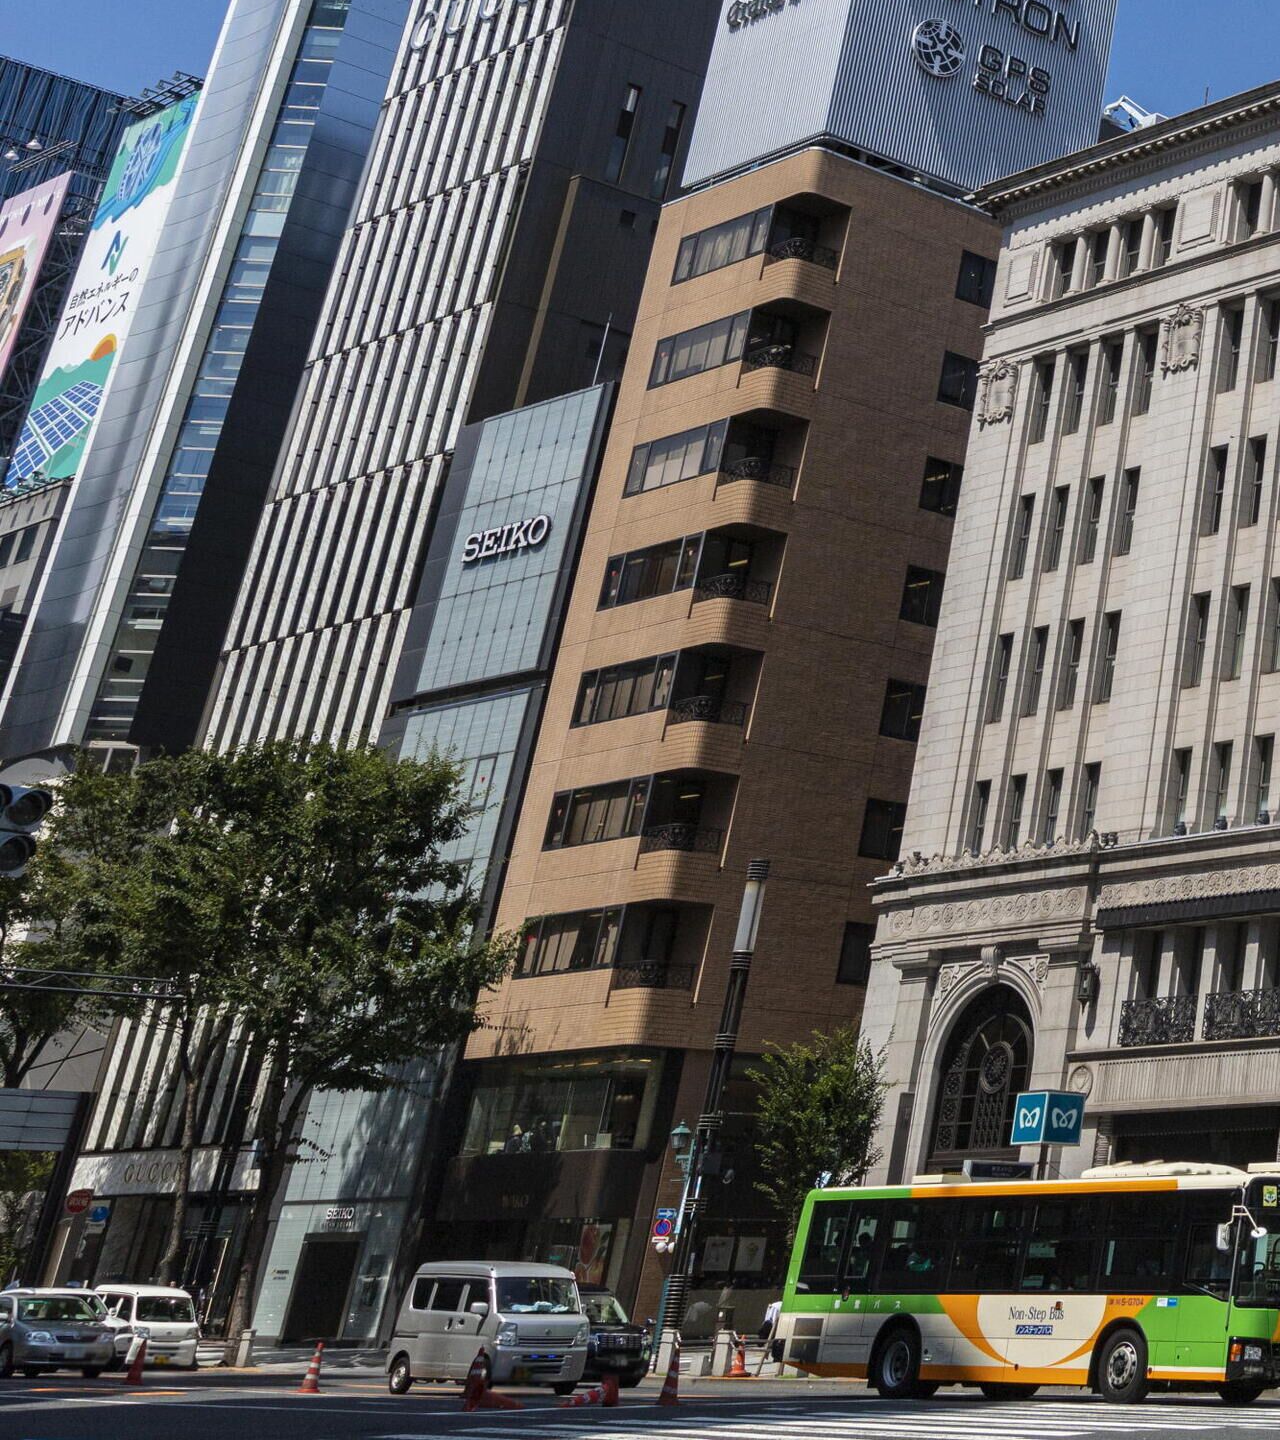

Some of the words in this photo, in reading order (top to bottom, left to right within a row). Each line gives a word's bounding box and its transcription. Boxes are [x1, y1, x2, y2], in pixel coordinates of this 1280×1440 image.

[977, 43, 1051, 95] GPS
[973, 73, 1046, 118] SOLAR
[69, 267, 139, 310] 自然エネルギーの
[59, 291, 131, 341] アドバンス
[461, 515, 550, 563] SEIKO
[124, 1163, 181, 1183] GUCCI
[325, 1207, 355, 1220] SEIKO
[1008, 1306, 1047, 1323] Non-Step
[1049, 1307, 1065, 1320] Bus
[1016, 1326, 1053, 1335] ノンステップバス
